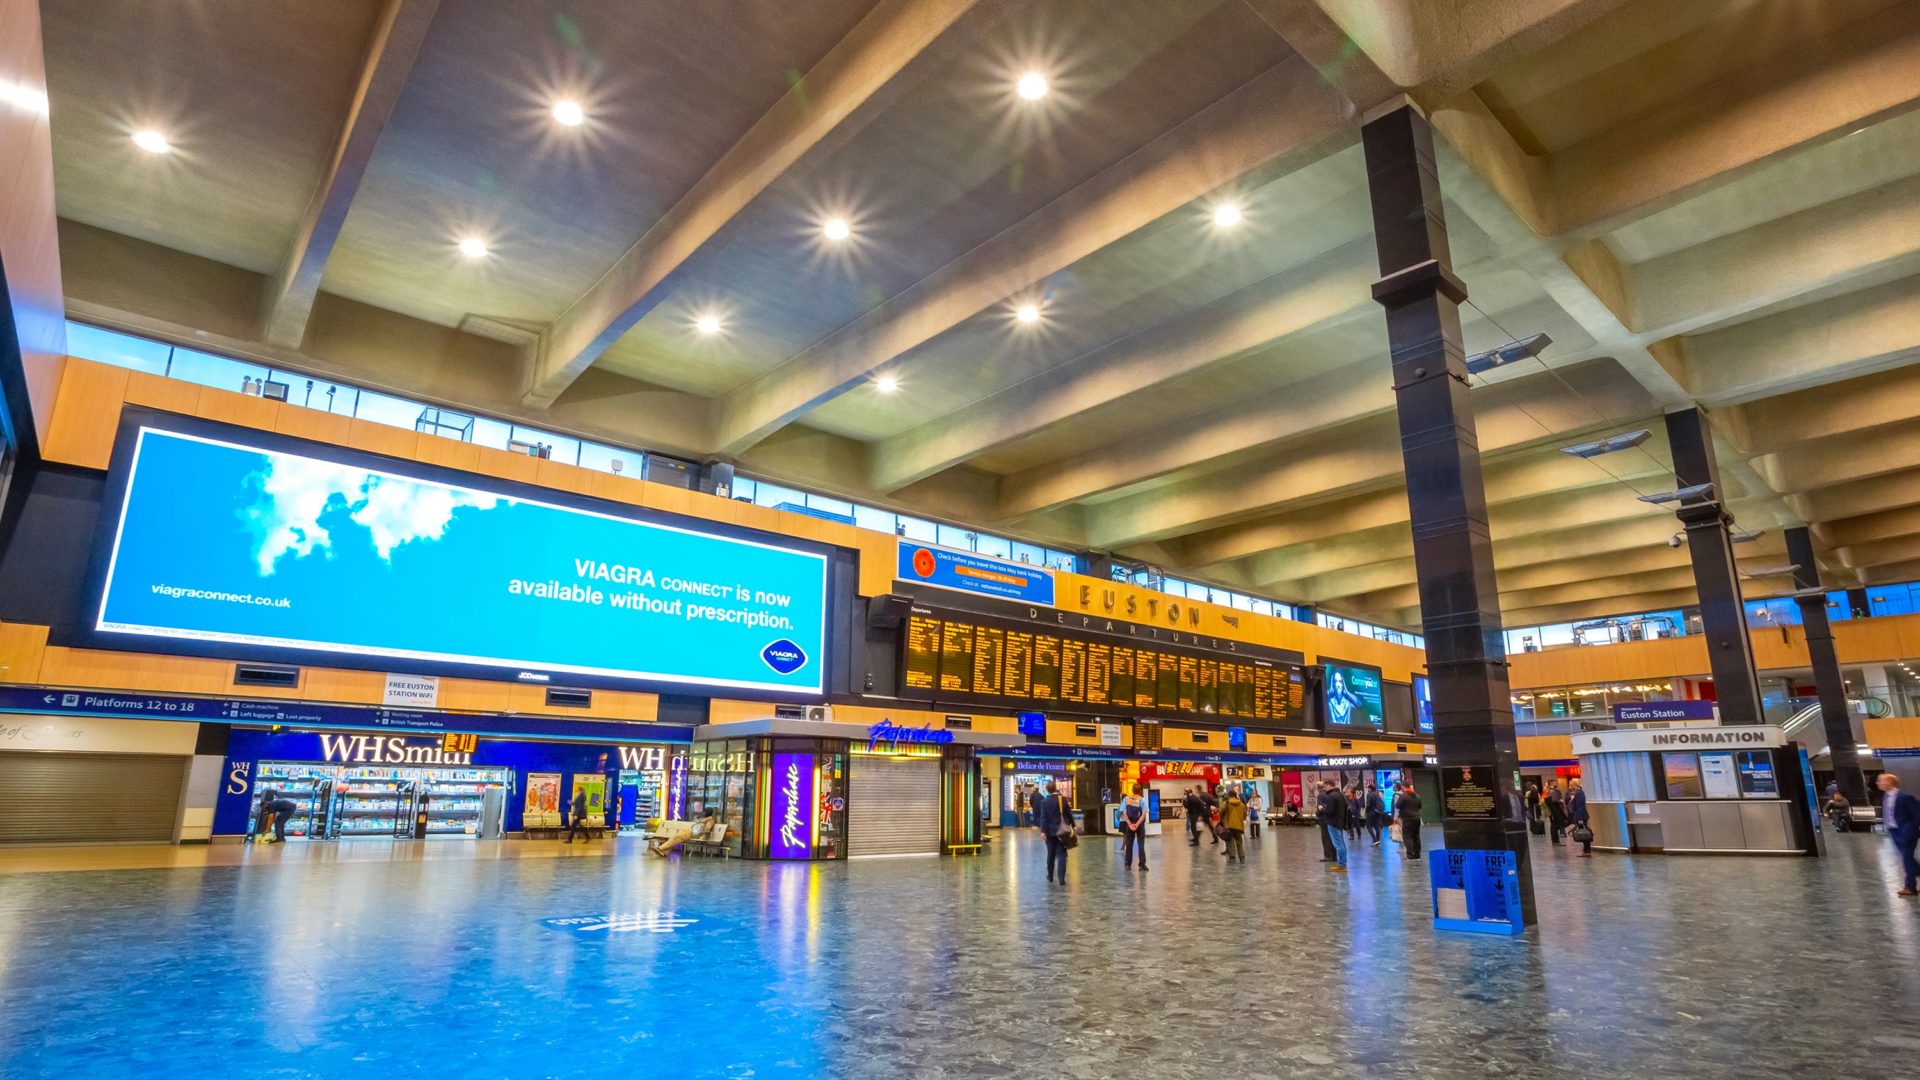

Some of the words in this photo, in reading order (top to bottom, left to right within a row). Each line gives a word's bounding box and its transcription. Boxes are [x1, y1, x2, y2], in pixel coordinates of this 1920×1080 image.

[938, 552, 951, 560] Check
[952, 555, 966, 564] before
[967, 559, 975, 567] you
[976, 560, 989, 569] travel
[1007, 566, 1016, 575] May
[1017, 569, 1027, 577] bank
[1027, 571, 1043, 581] holiday
[575, 558, 656, 588] VIAGRA
[736, 584, 751, 601] is
[755, 590, 791, 607] now
[151, 583, 291, 609] viagraconnect.co.uk
[508, 578, 604, 606] available
[609, 591, 682, 616] without
[686, 604, 794, 631] prescription.
[1080, 584, 1200, 627] EUSTON
[1030, 606, 1236, 651] DEPARTURES
[770, 650, 799, 659] VIAGRA
[388, 681, 406, 689] FREE
[407, 683, 435, 691] EUSTON
[388, 690, 418, 698] STATION
[85, 696, 143, 709] Platforms
[146, 701, 161, 710] 12
[165, 702, 177, 711] to
[180, 702, 194, 711] 18
[253, 711, 275, 719] luggage
[1621, 710, 1651, 719] Euston
[1652, 709, 1685, 718] Station
[1652, 731, 1765, 745] INFORMATION
[232, 761, 250, 770] WH
[1017, 761, 1036, 770] Delice
[1037, 762, 1045, 770] de
[1045, 762, 1065, 771] France
[1329, 757, 1348, 766] BODY
[227, 770, 249, 795] S
[780, 763, 806, 849] Paperchase
[1448, 854, 1467, 865] FRE
[1485, 855, 1506, 867] FRE
